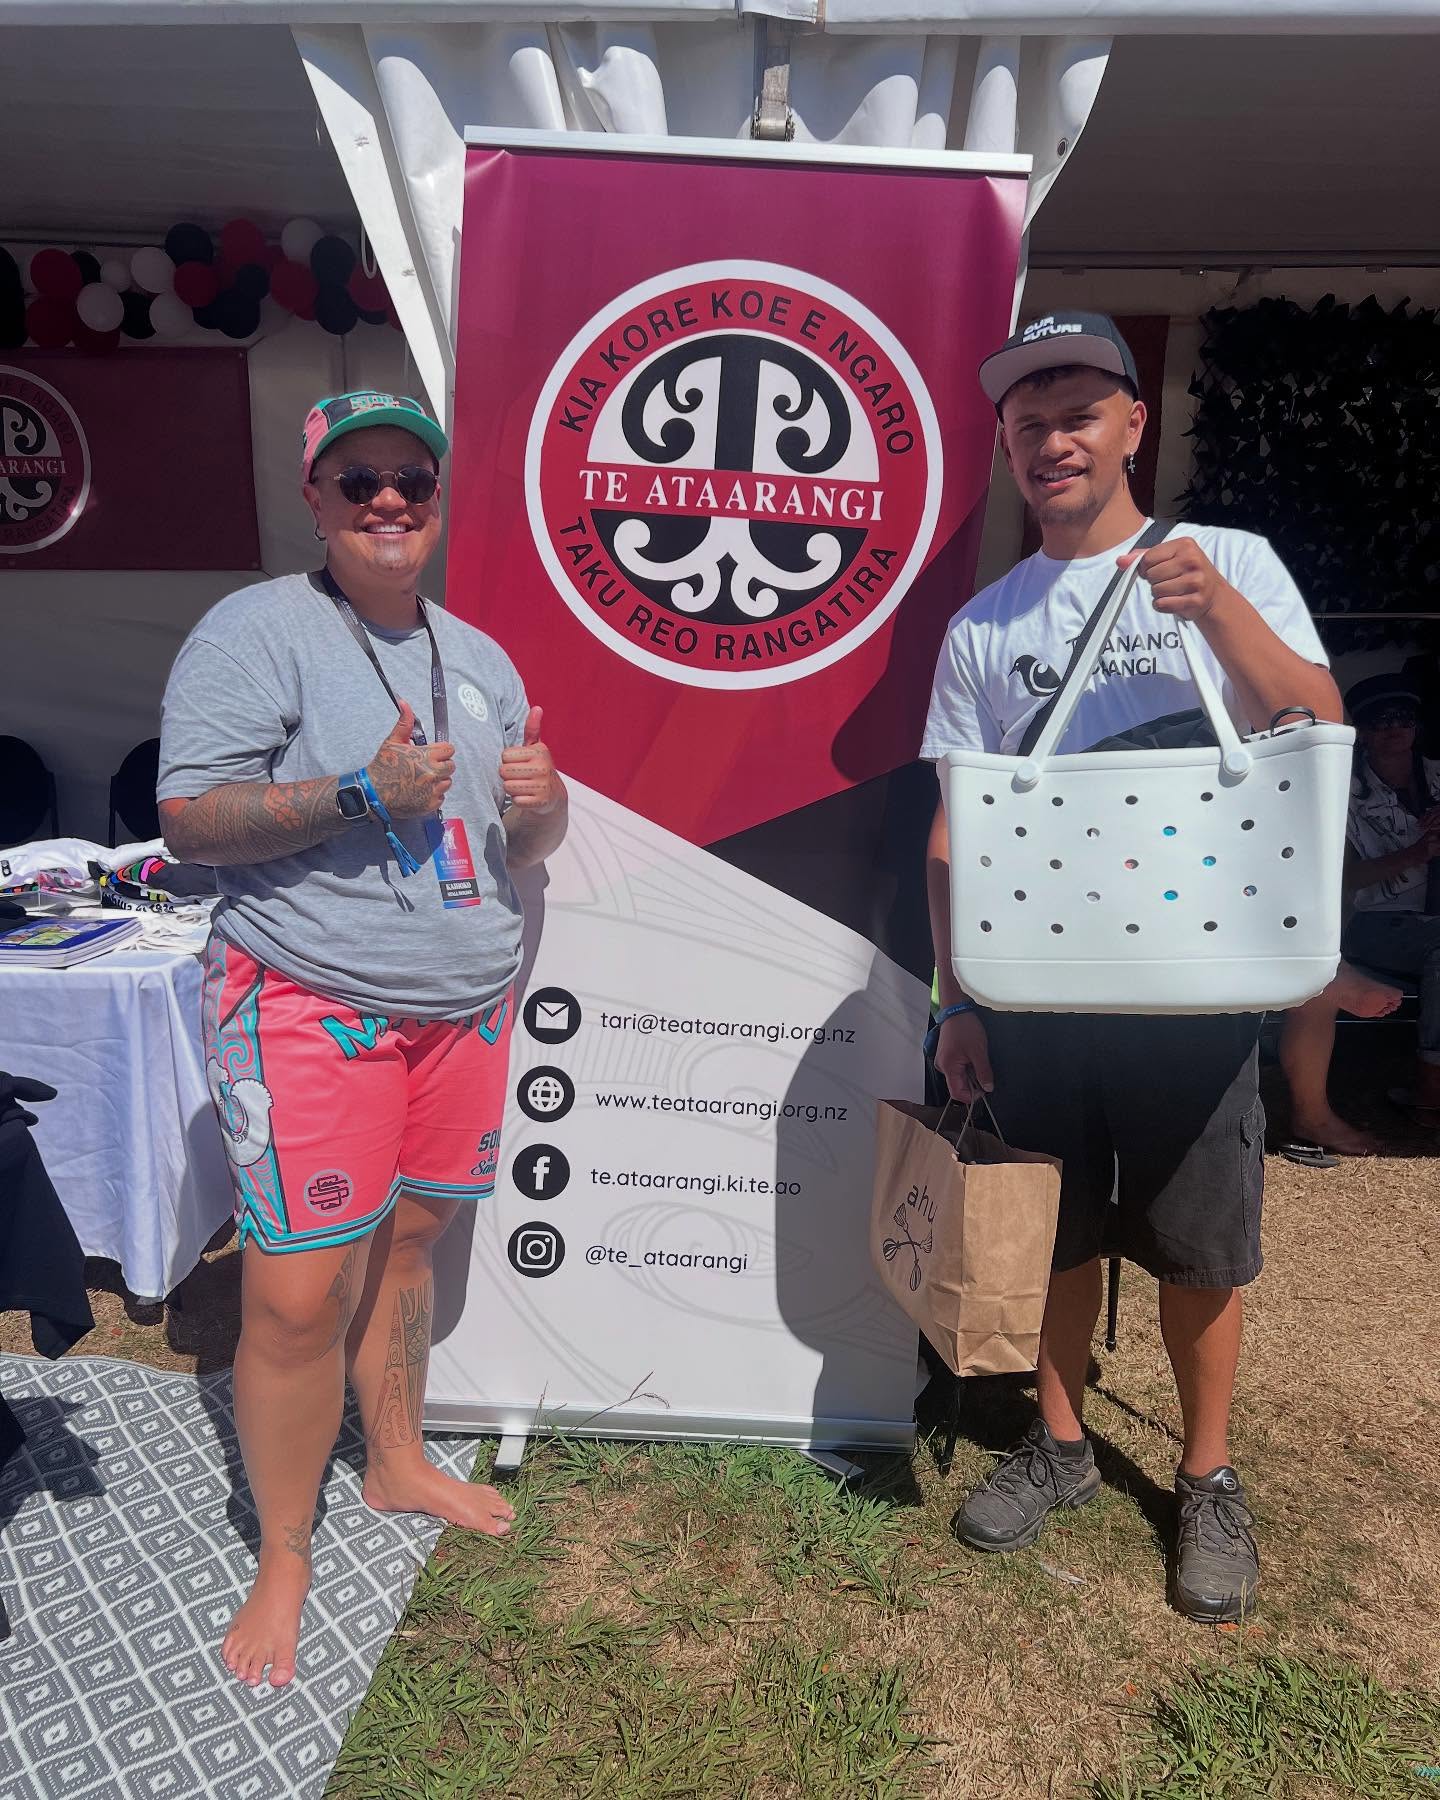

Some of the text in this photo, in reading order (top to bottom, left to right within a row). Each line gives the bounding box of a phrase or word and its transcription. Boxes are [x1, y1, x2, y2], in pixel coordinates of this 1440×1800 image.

[1022, 323, 1082, 343] FUTURE
[1023, 316, 1055, 334] OUR
[559, 290, 914, 455] KIA KORE KOE E NGARO
[579, 470, 884, 522] TE ATAARANGI
[559, 516, 898, 661] TAKU REO RANGATIRA
[600, 1012, 856, 1044] tari@teataarangi.org.nz
[596, 1092, 848, 1122] www.teataarangi.org.nz
[590, 1168, 801, 1196] te.ataarangi.ki.te.ao
[907, 1185, 938, 1223] ahu
[585, 1245, 748, 1274] @te_ataarangi
